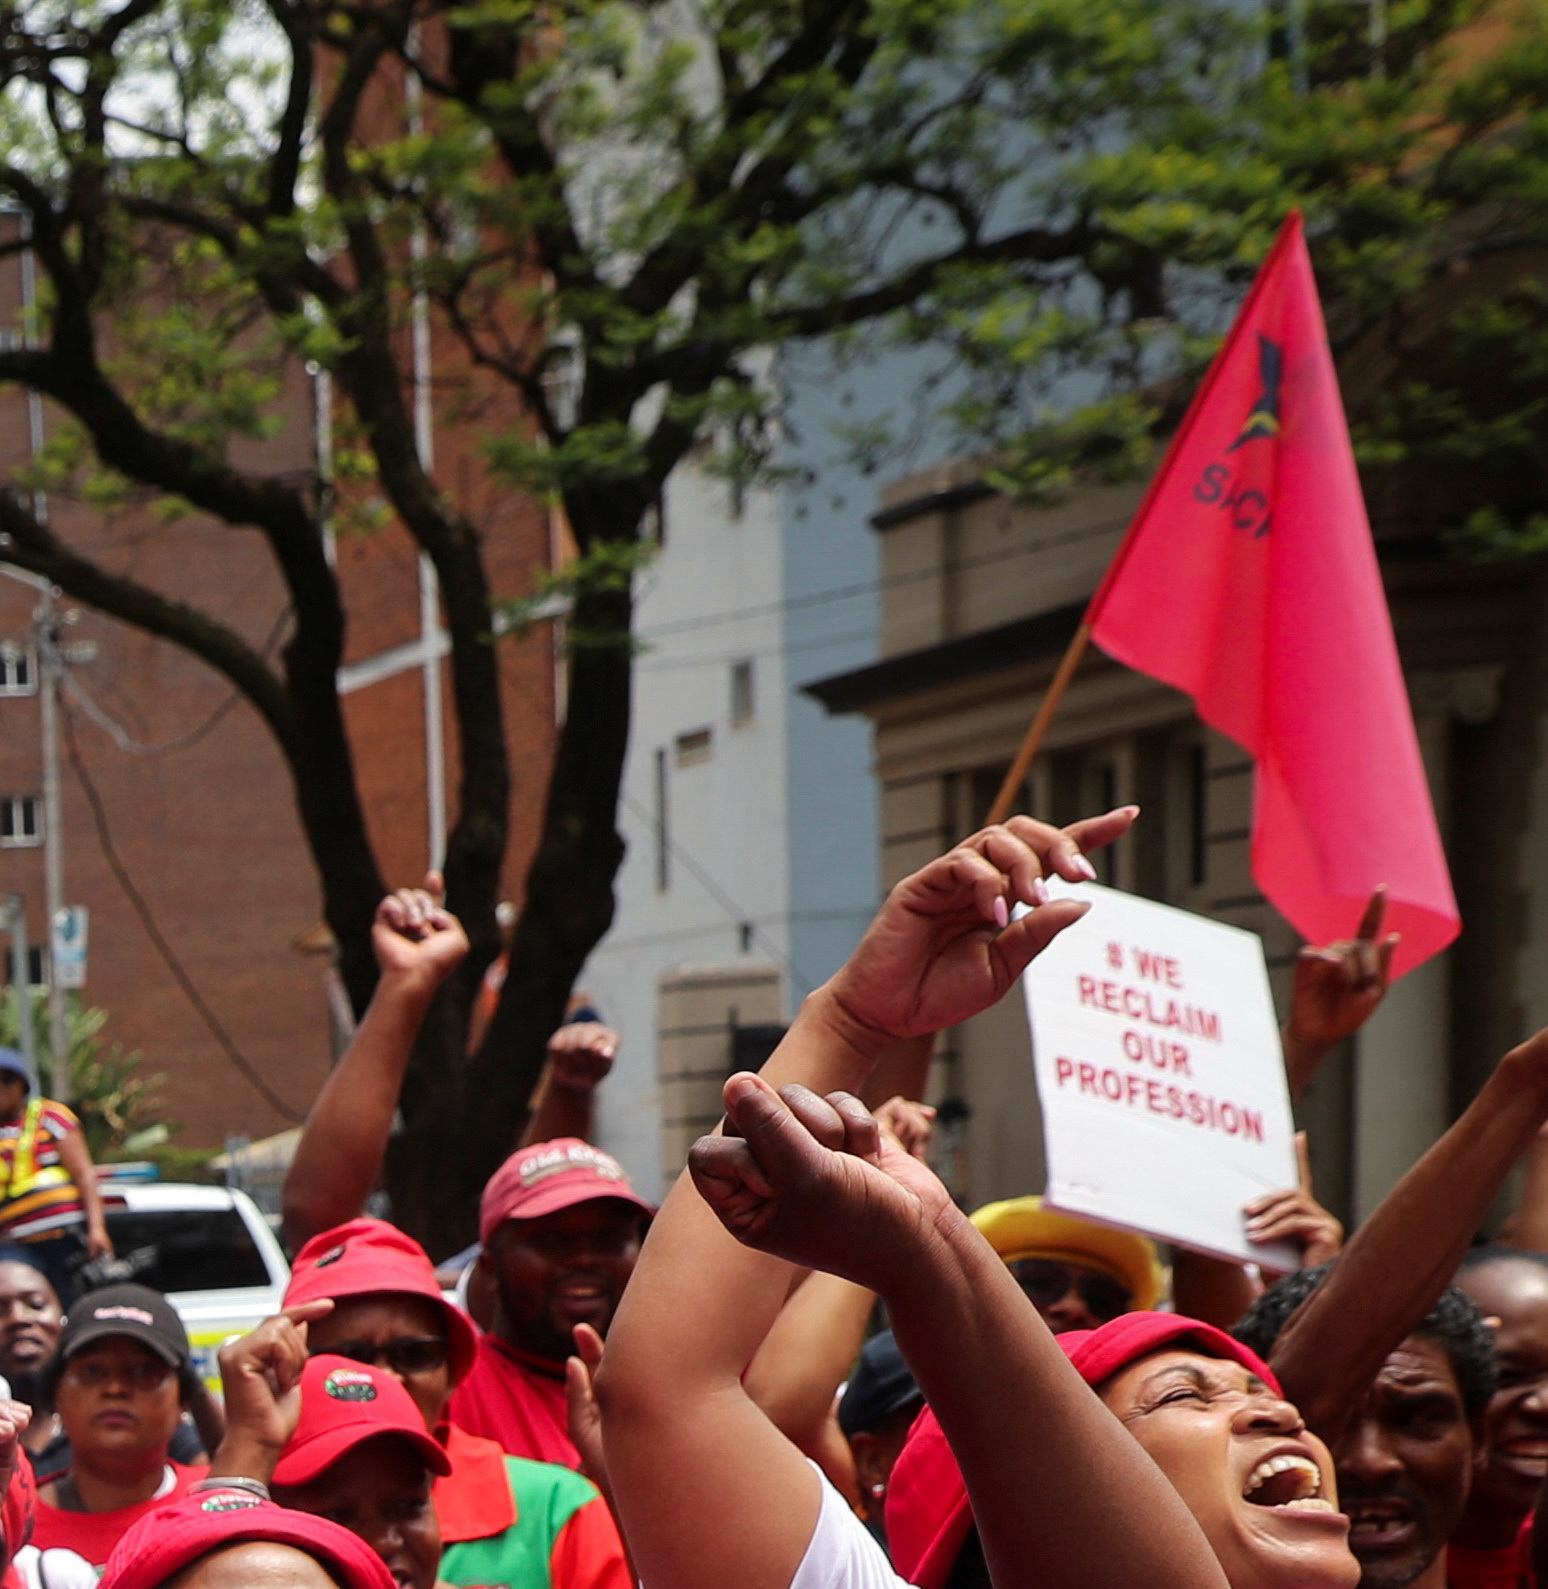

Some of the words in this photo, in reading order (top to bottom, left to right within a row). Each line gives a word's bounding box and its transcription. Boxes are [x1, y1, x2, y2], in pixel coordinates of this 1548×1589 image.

[1133, 947, 1184, 990] WE
[1078, 974, 1223, 1044] RECLAIM
[1122, 1030, 1193, 1078] OUR
[1055, 1056, 1266, 1144] PROFESSION
